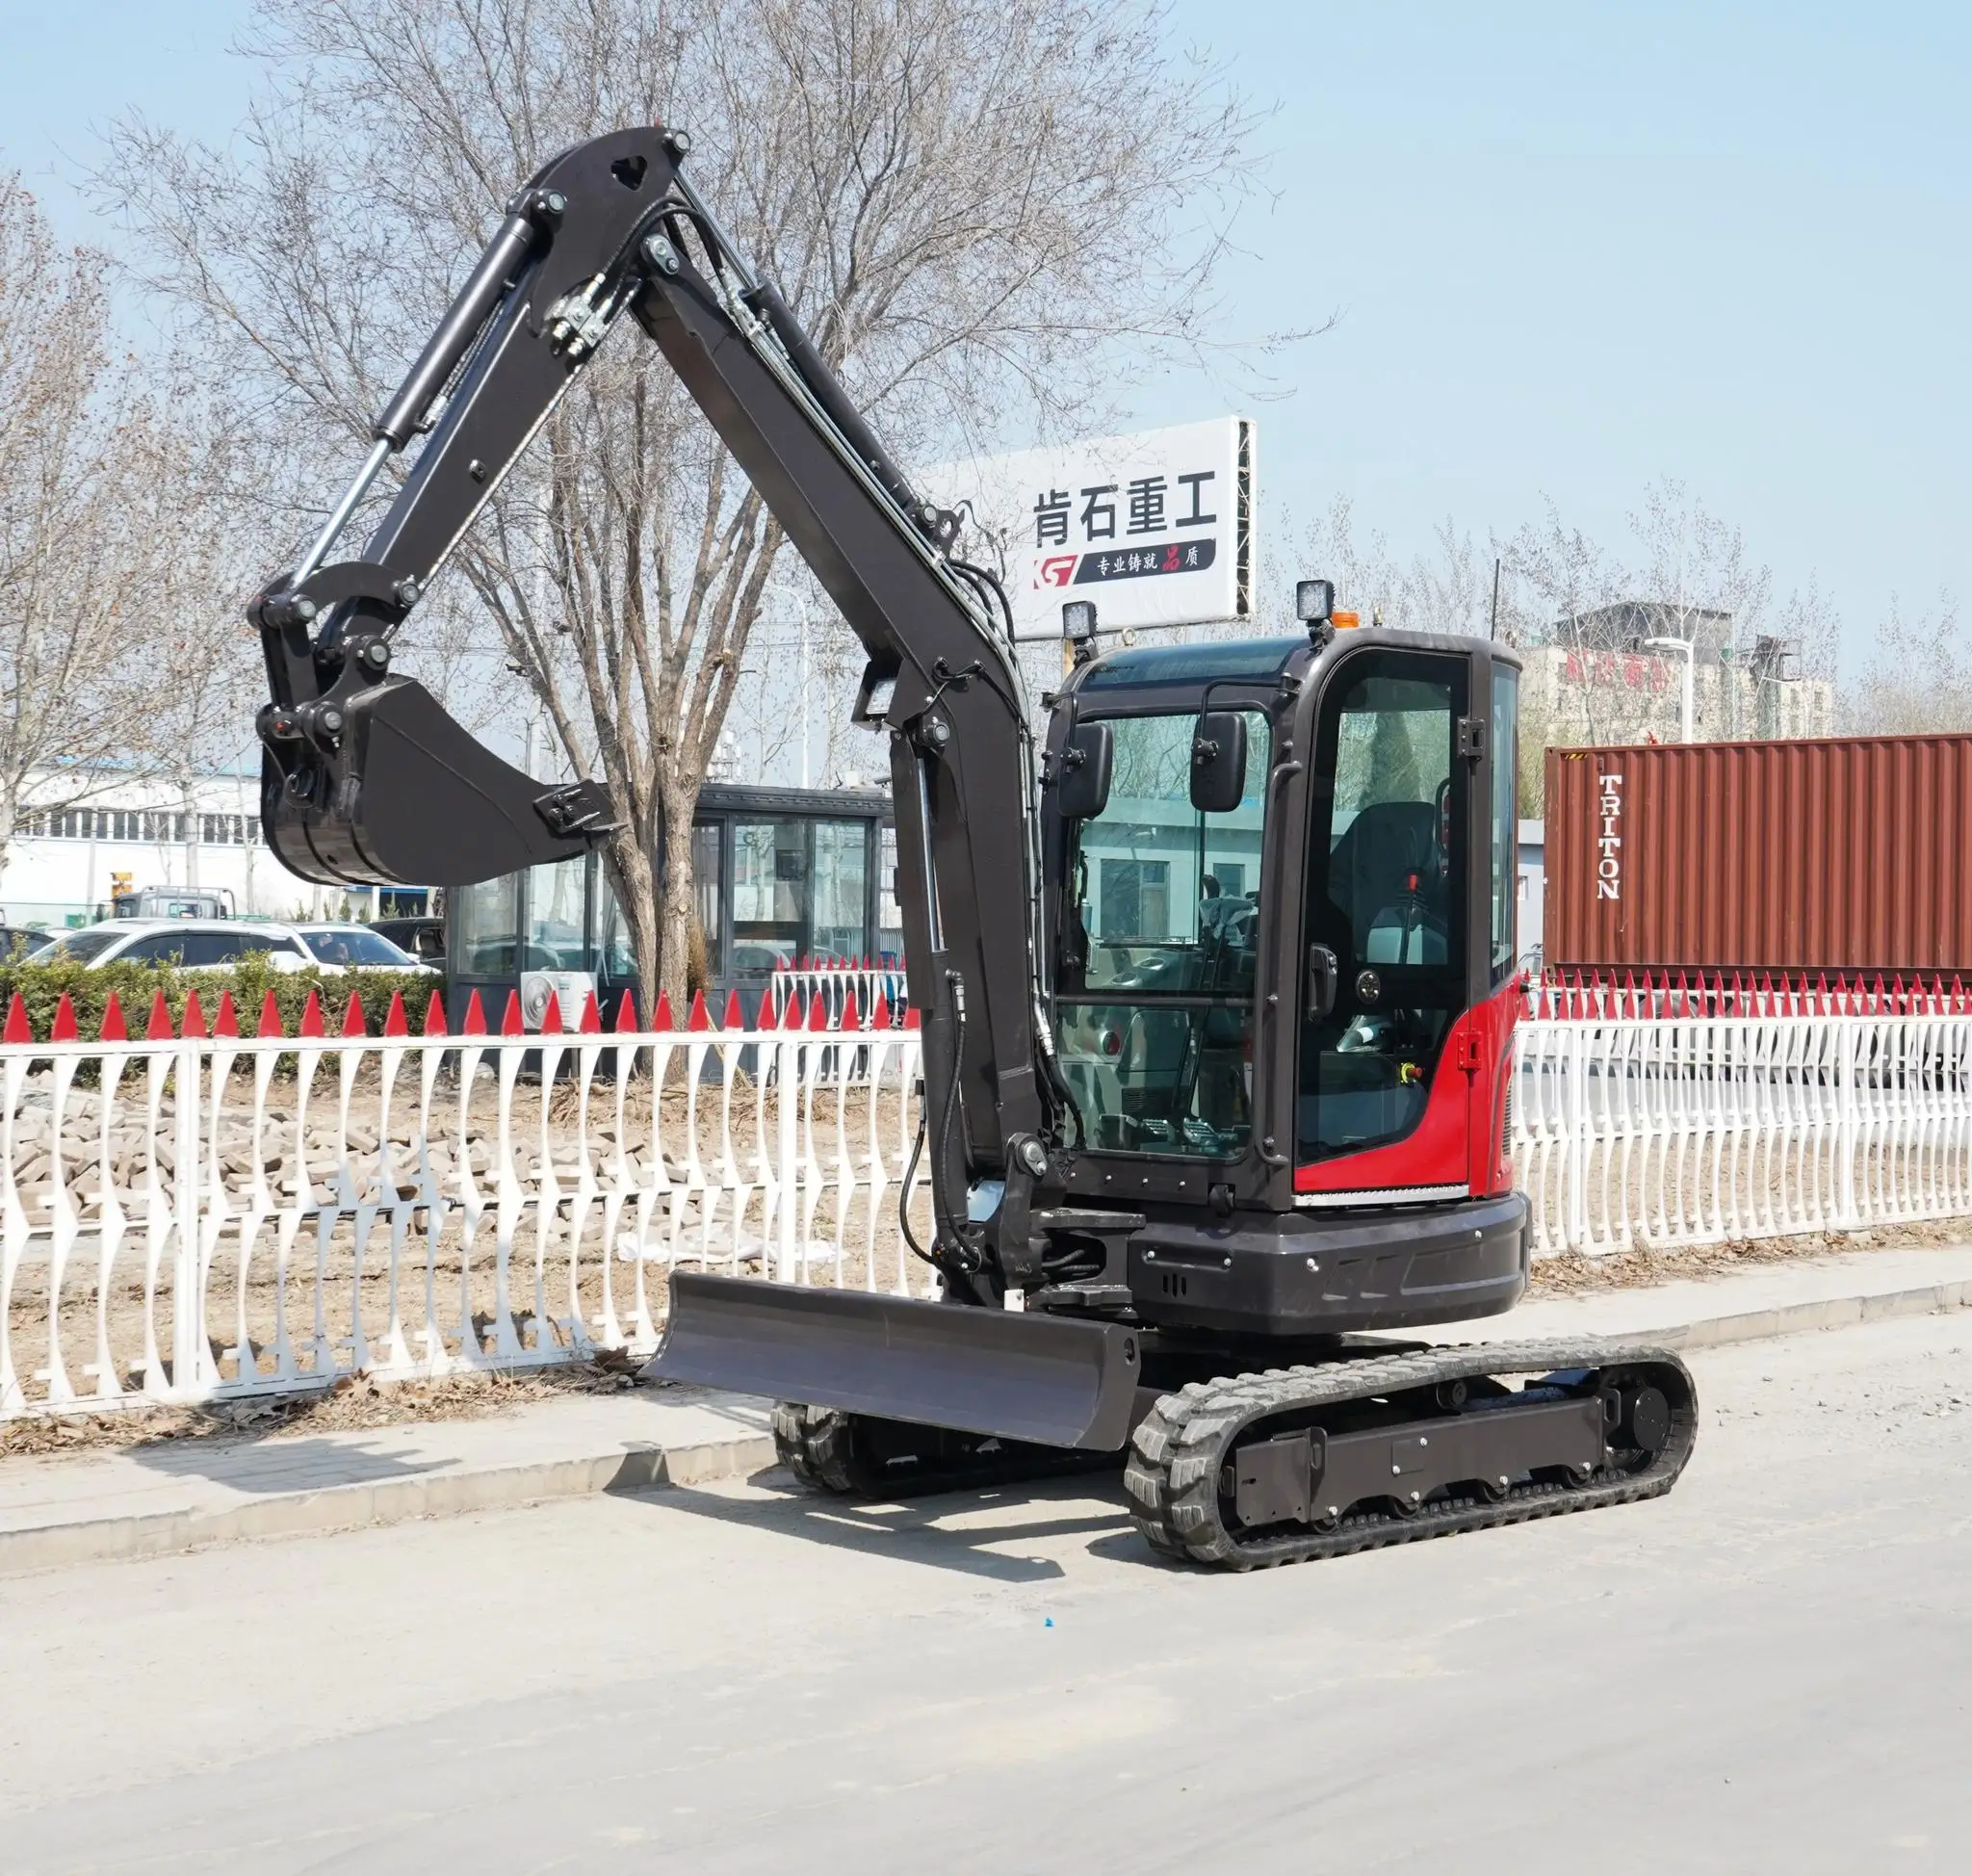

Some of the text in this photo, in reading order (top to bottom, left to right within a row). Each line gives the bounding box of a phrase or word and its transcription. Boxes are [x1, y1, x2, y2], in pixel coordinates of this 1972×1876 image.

[1033, 471, 1217, 548] 肯石重工
[1097, 544, 1199, 576] 专业铸就品质
[1596, 774, 1622, 899] TRITON
